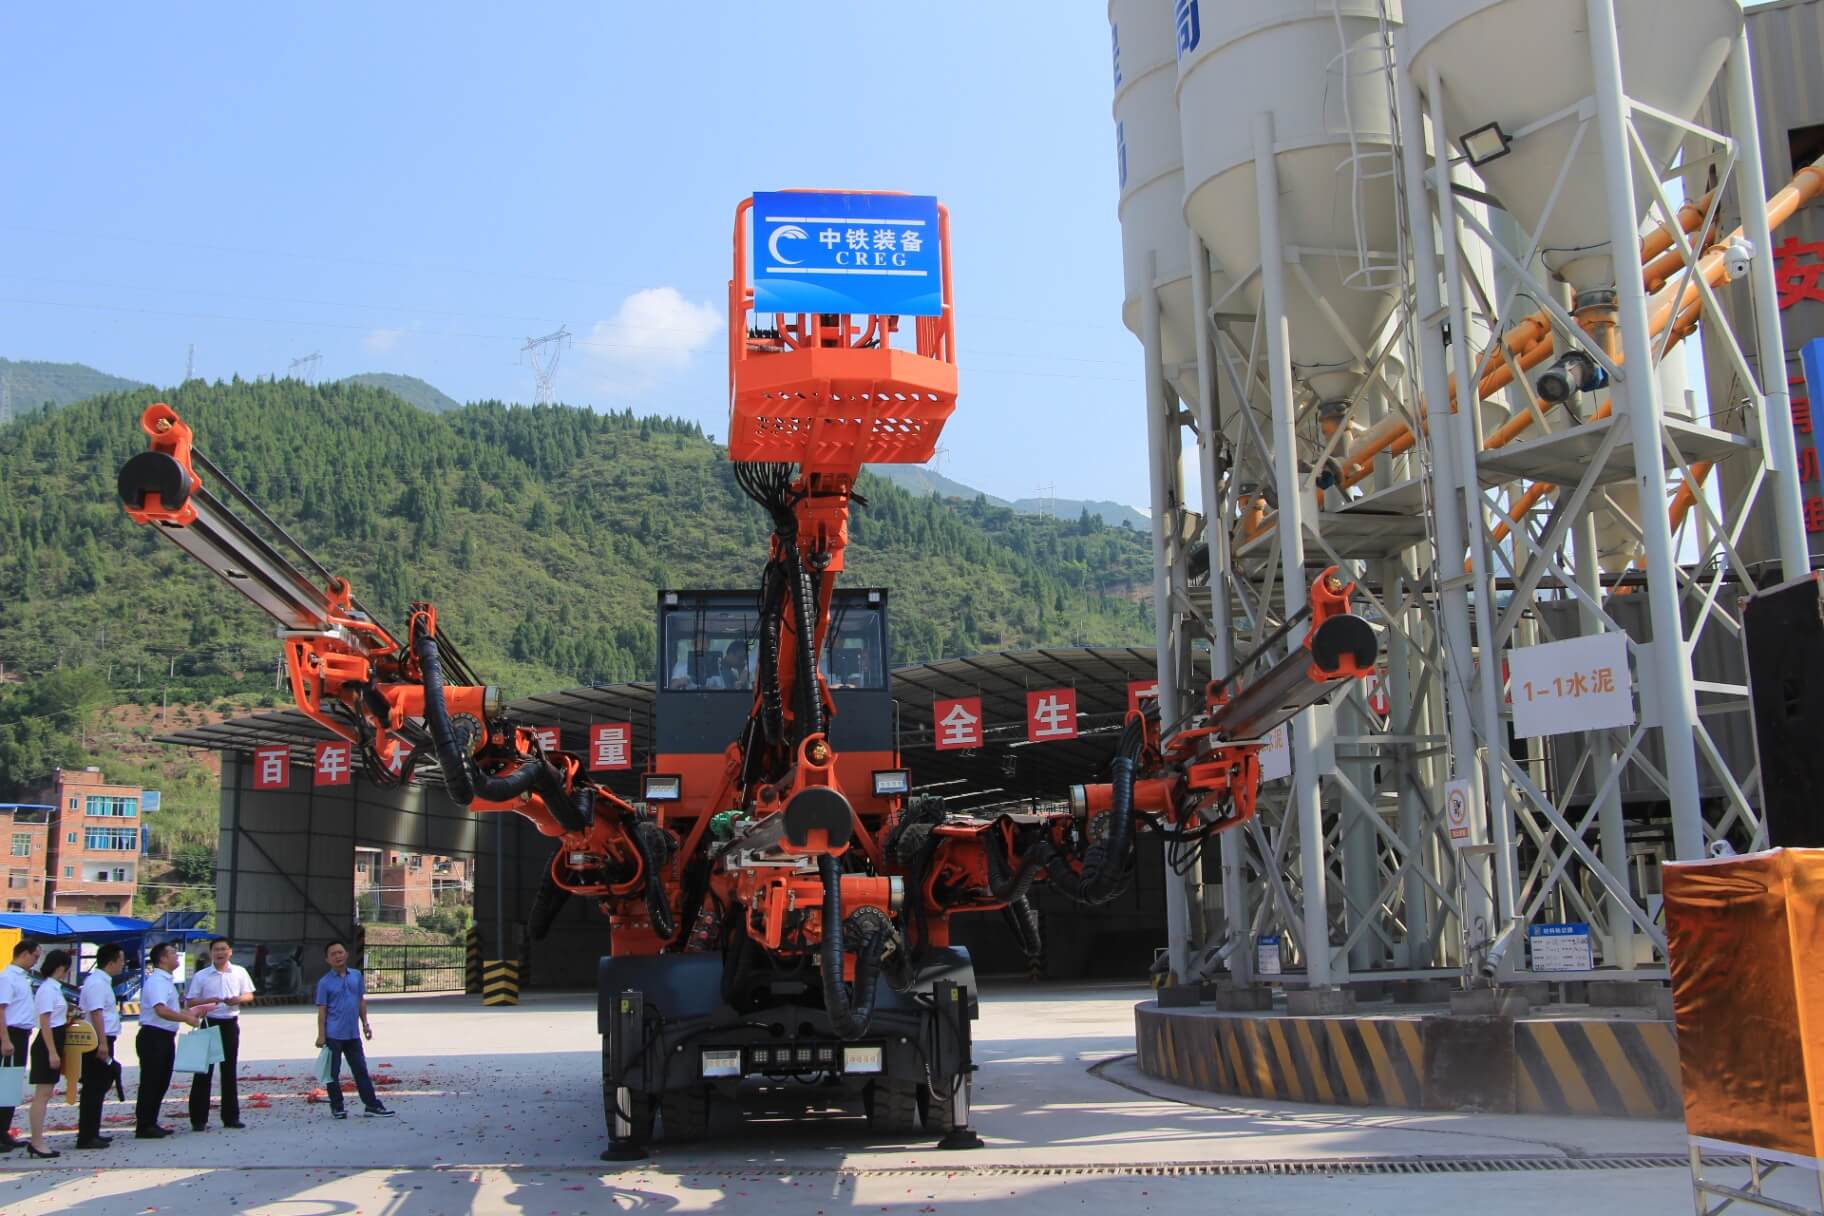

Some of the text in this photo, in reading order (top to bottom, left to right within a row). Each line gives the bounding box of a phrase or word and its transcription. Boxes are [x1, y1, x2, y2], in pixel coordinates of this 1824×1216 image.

[819, 228, 923, 253] 中铁装备
[836, 251, 907, 267] CREG
[1522, 667, 1616, 702] 1-1水泥
[940, 695, 1073, 745] 全 生
[258, 750, 287, 784] 百
[319, 746, 348, 781] 年
[594, 728, 628, 766] 量
